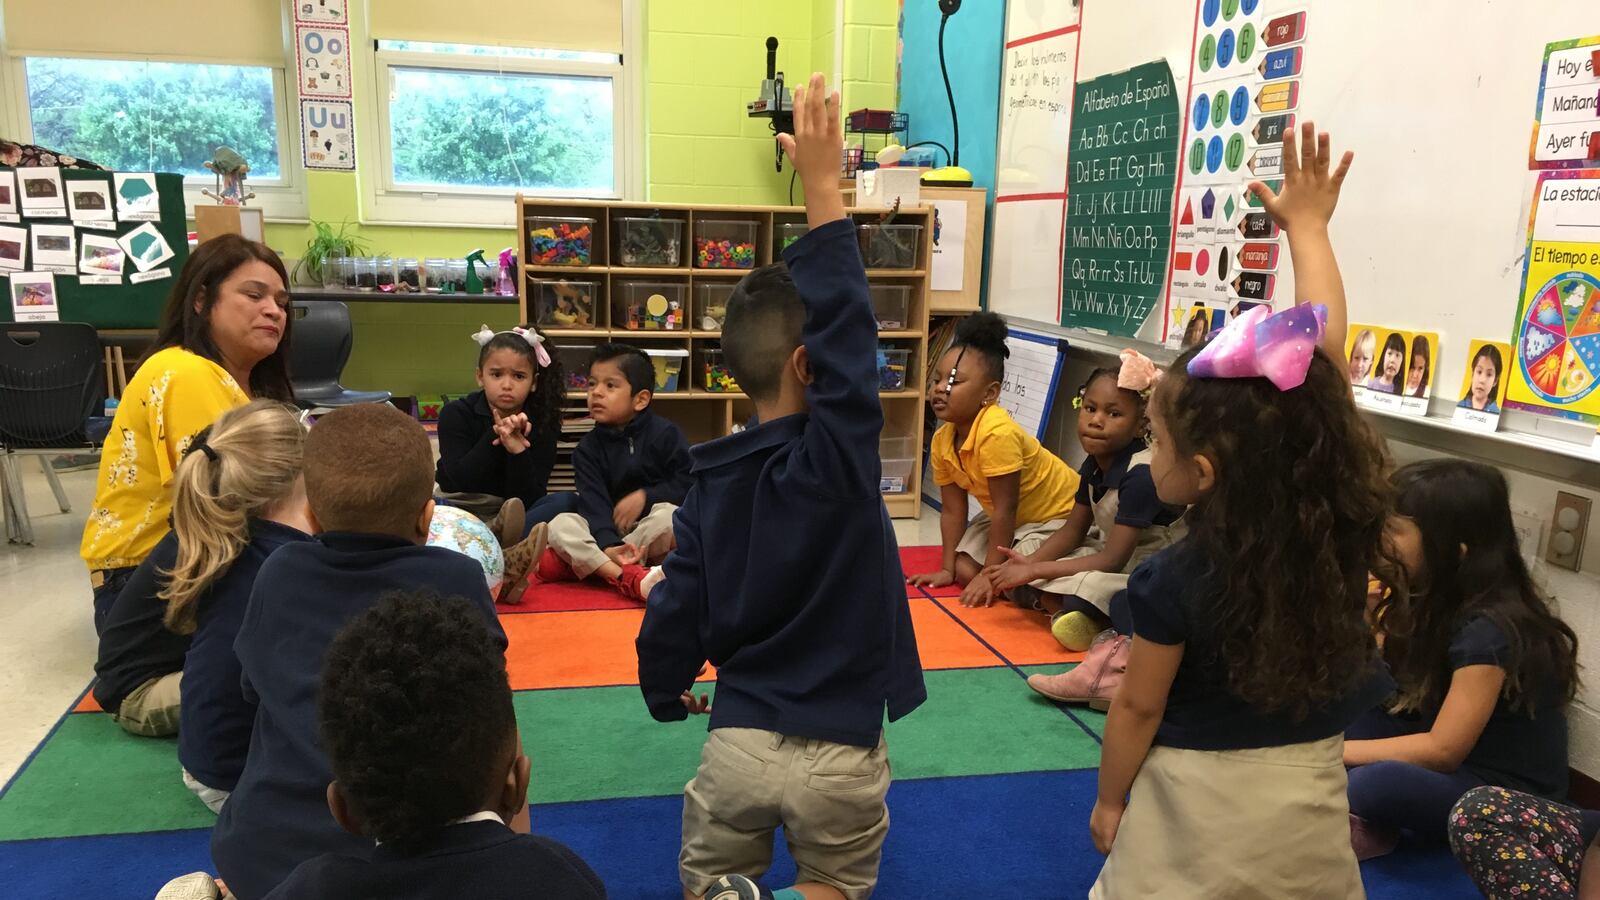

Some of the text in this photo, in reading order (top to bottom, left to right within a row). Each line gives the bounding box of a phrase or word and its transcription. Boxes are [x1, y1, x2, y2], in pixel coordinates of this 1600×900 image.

[1276, 24, 1289, 38] rojo
[1203, 29, 1250, 67] 4 5 6
[1273, 55, 1287, 69] azul
[1557, 58, 1593, 78] Hoy e
[1082, 72, 1171, 113] Alfabeto de Español
[1199, 91, 1244, 126] 7 8 9
[1078, 114, 1167, 151] Aa Bb Cc Ch ch
[1267, 122, 1278, 139] gris
[1192, 142, 1204, 171] 10
[1229, 139, 1241, 168] 12
[1545, 133, 1576, 154] Ayer
[1076, 151, 1165, 187] Dd Ee Ff Gg Hh
[1543, 186, 1600, 201] La estaci
[1074, 193, 1082, 216] Ii
[1087, 192, 1098, 224] Jj
[1103, 191, 1116, 215] Kk
[1123, 190, 1136, 214] Ll
[1251, 218, 1266, 231] café
[1072, 223, 1158, 258] Mm Nn Ññ Oo Pp
[1245, 251, 1269, 264] naranja
[1534, 246, 1600, 269] El tiempo e
[1072, 258, 1155, 289] Qq Rr rr Ss Tt Uu
[1244, 280, 1262, 294] negro
[1070, 289, 1147, 326] Vv Ww Xx Yy Zz
[1015, 374, 1026, 397] los
